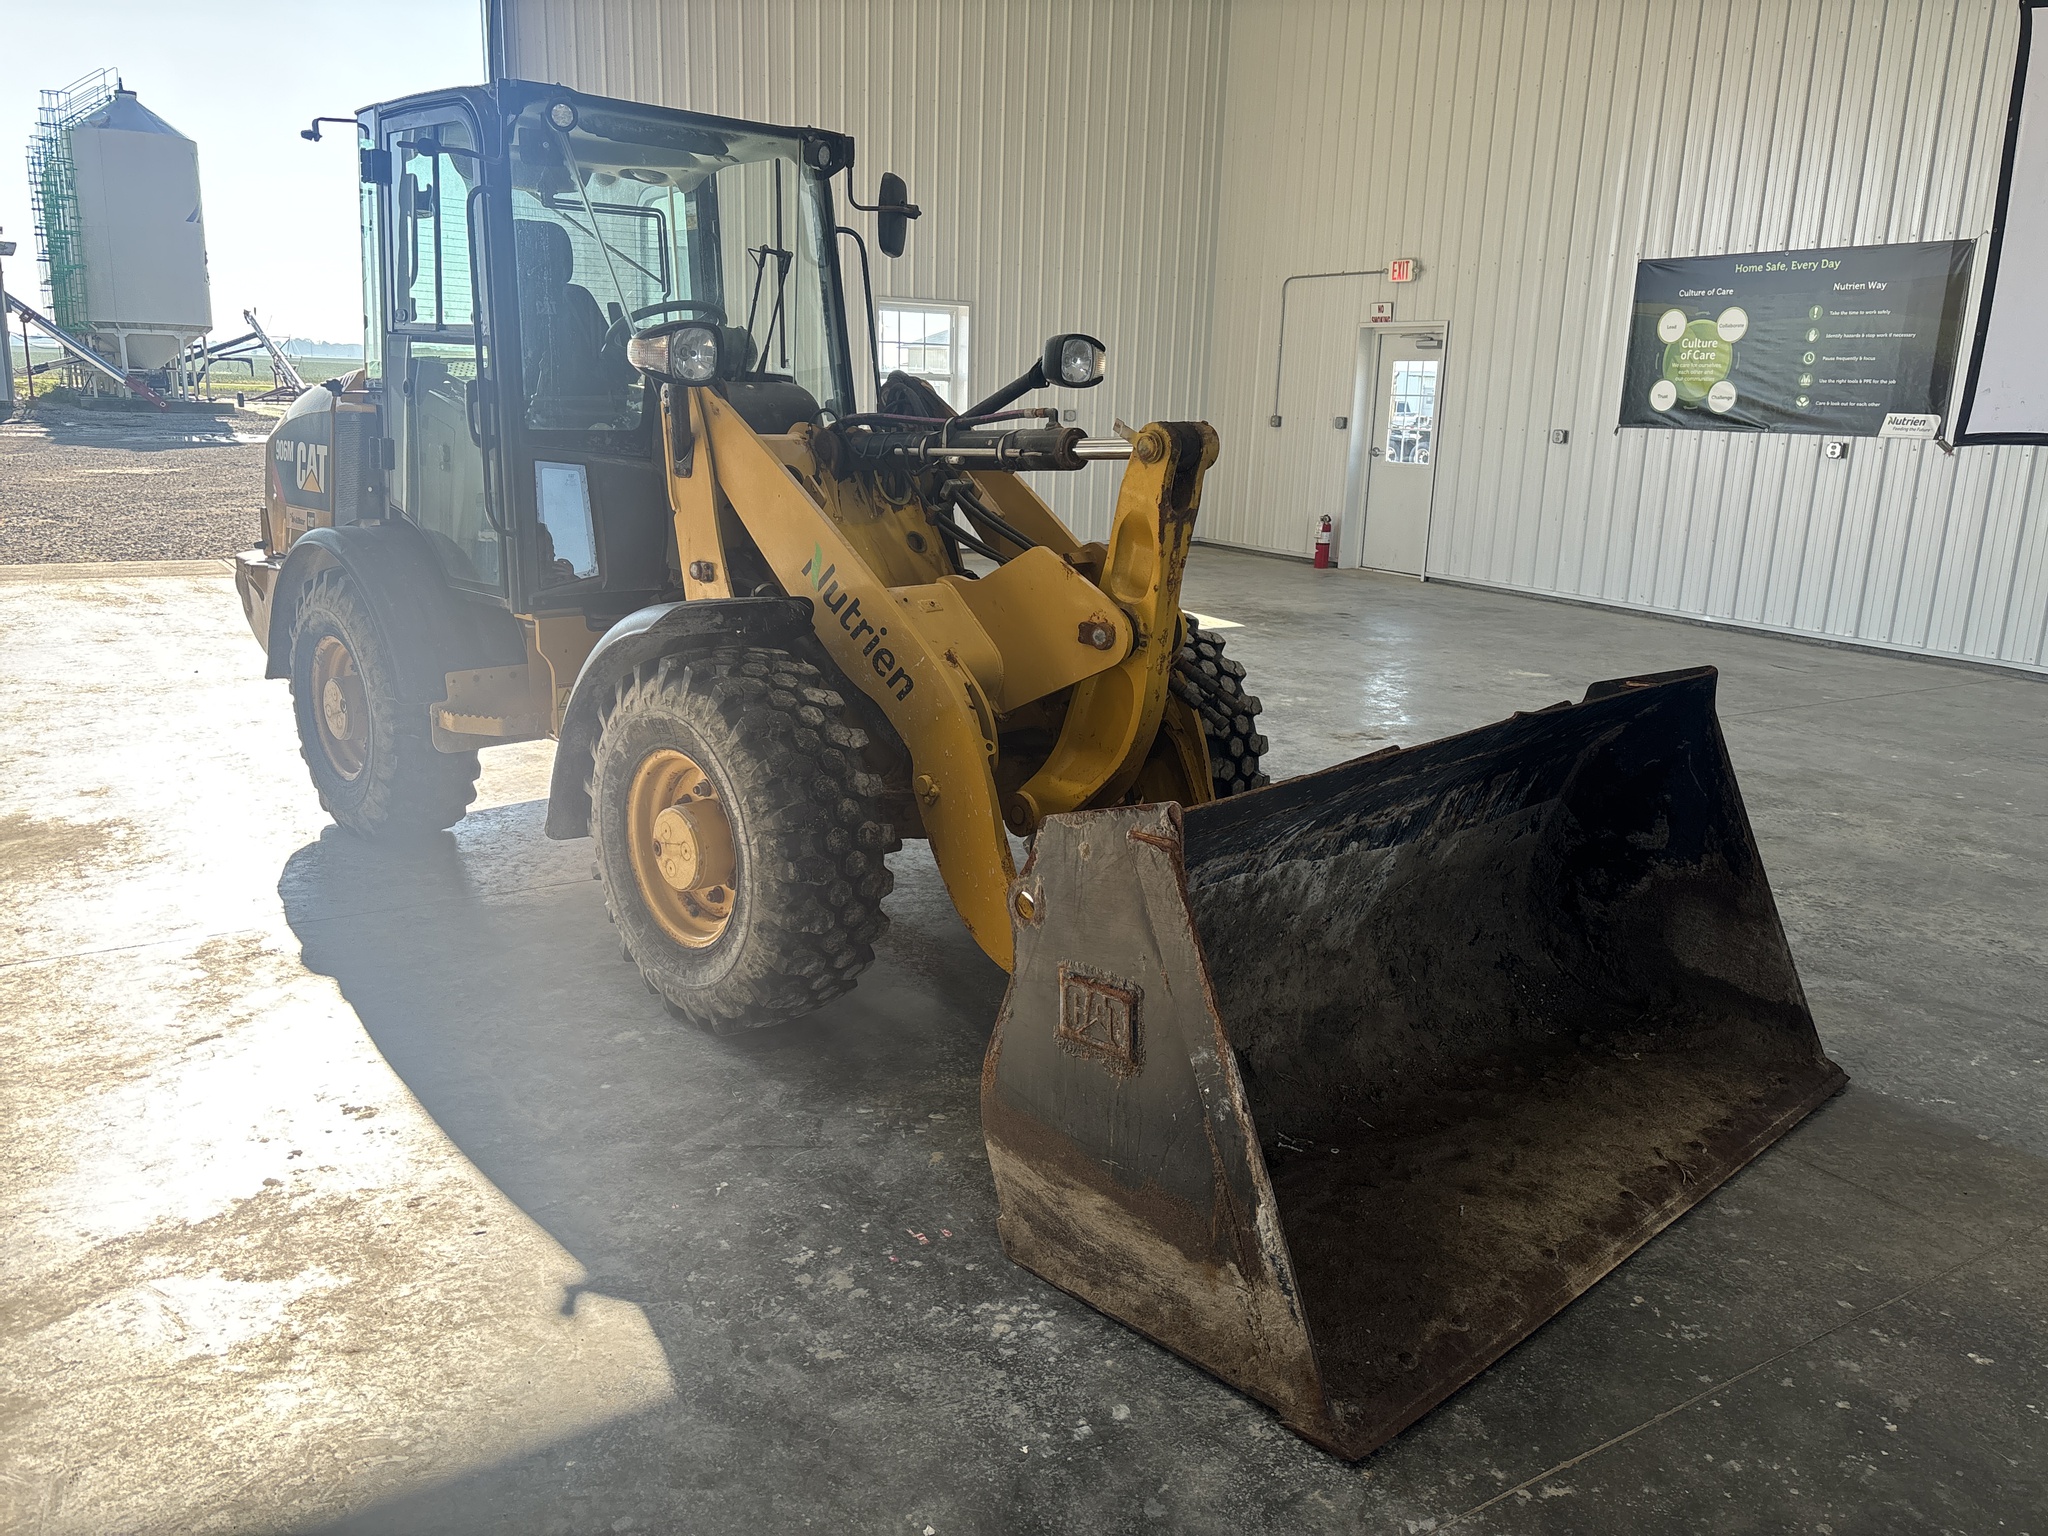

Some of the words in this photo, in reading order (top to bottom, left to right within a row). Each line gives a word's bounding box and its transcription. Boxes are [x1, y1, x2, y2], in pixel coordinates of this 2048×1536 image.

[1391, 260, 1410, 280] EXIT
[1735, 264, 1763, 273] Home
[1765, 262, 1788, 272] Safe,
[1791, 261, 1819, 272] Every
[1821, 259, 1841, 270] Day
[1833, 282, 1865, 291] Nutrien
[1867, 281, 1888, 290] Way
[1679, 288, 1706, 297] Culture
[1707, 288, 1715, 296] of
[1716, 287, 1734, 296] Care
[1377, 304, 1384, 314] NO
[1681, 338, 1718, 348] Culture
[1680, 350, 1692, 360] of
[1693, 350, 1716, 360] Care
[1887, 416, 1927, 426] Nutrien
[275, 439, 294, 462] 906M
[296, 441, 328, 494] CAT
[801, 540, 914, 702] Nutrien
